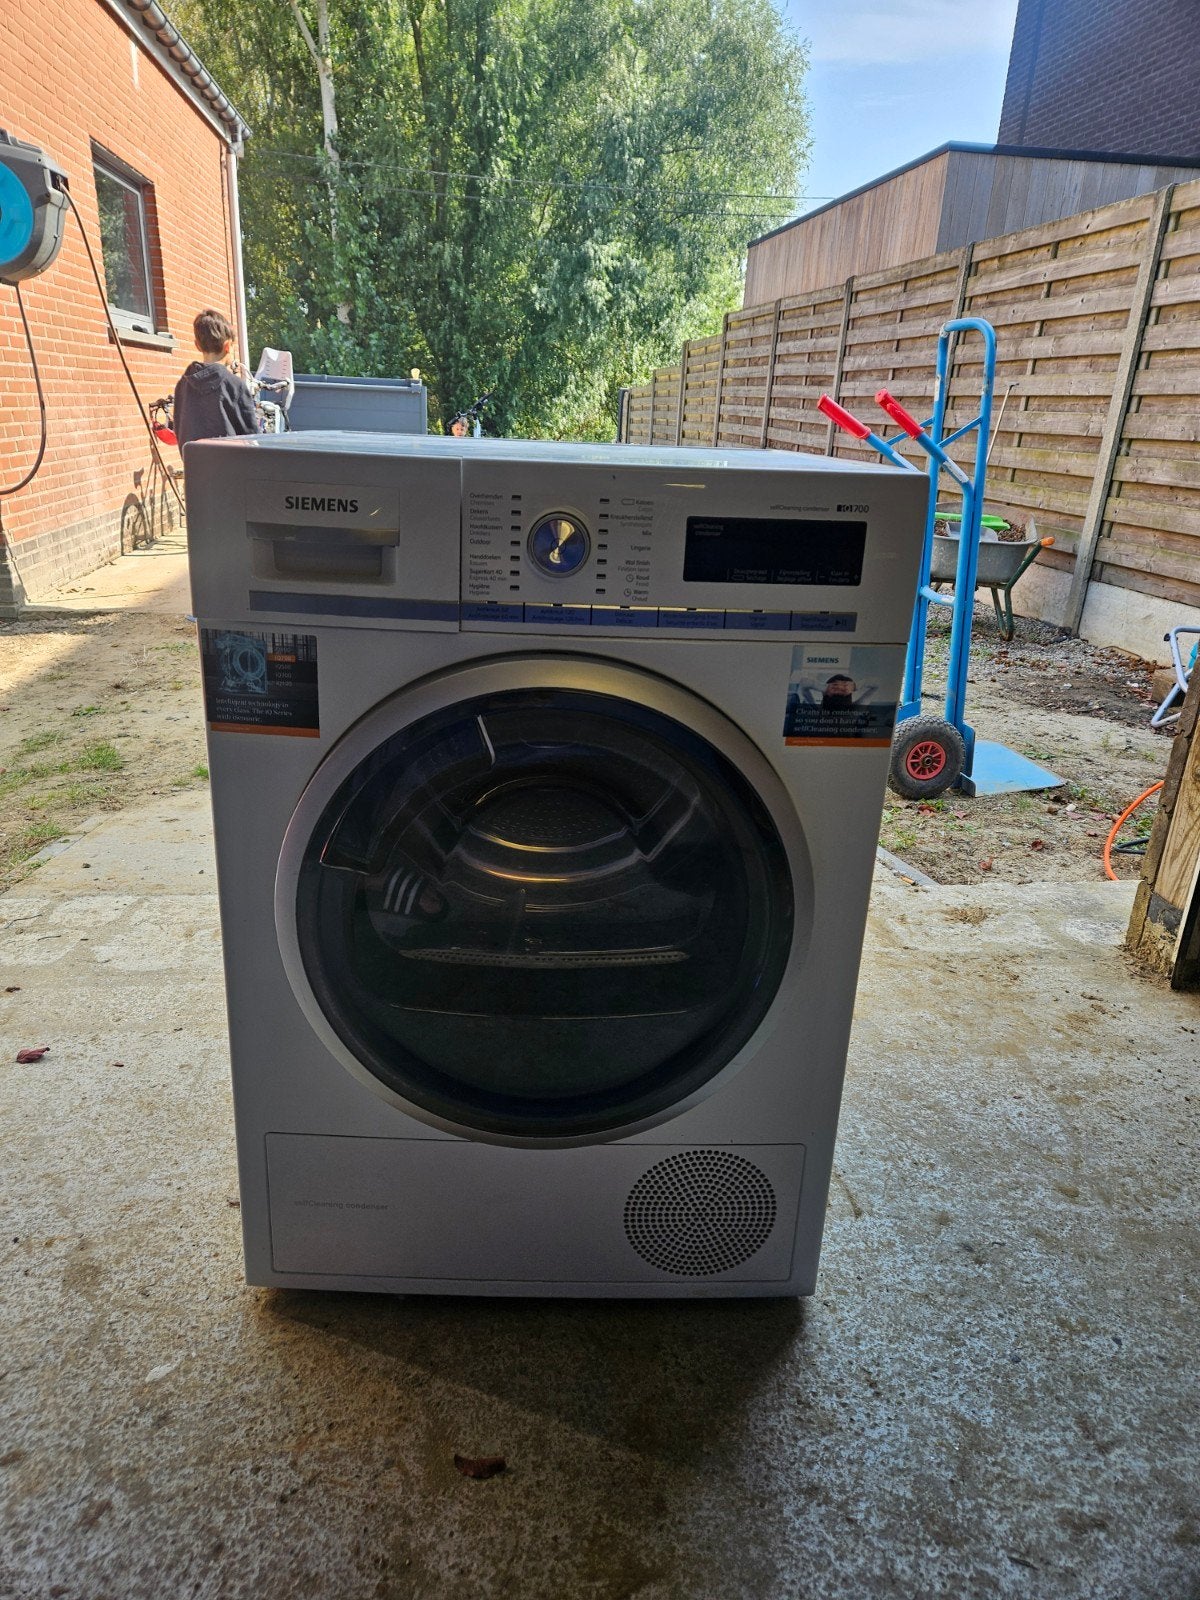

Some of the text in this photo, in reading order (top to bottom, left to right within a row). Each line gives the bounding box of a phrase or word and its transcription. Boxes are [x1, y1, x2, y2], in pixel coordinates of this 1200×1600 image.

[285, 495, 359, 513] SIEMENS
[806, 656, 839, 664] SIEMENS
[796, 707, 820, 715] Cleans
[804, 718, 819, 726] you
[839, 717, 855, 725] have
[794, 725, 838, 734] selfCleaning
[345, 1202, 389, 1210] condenser
